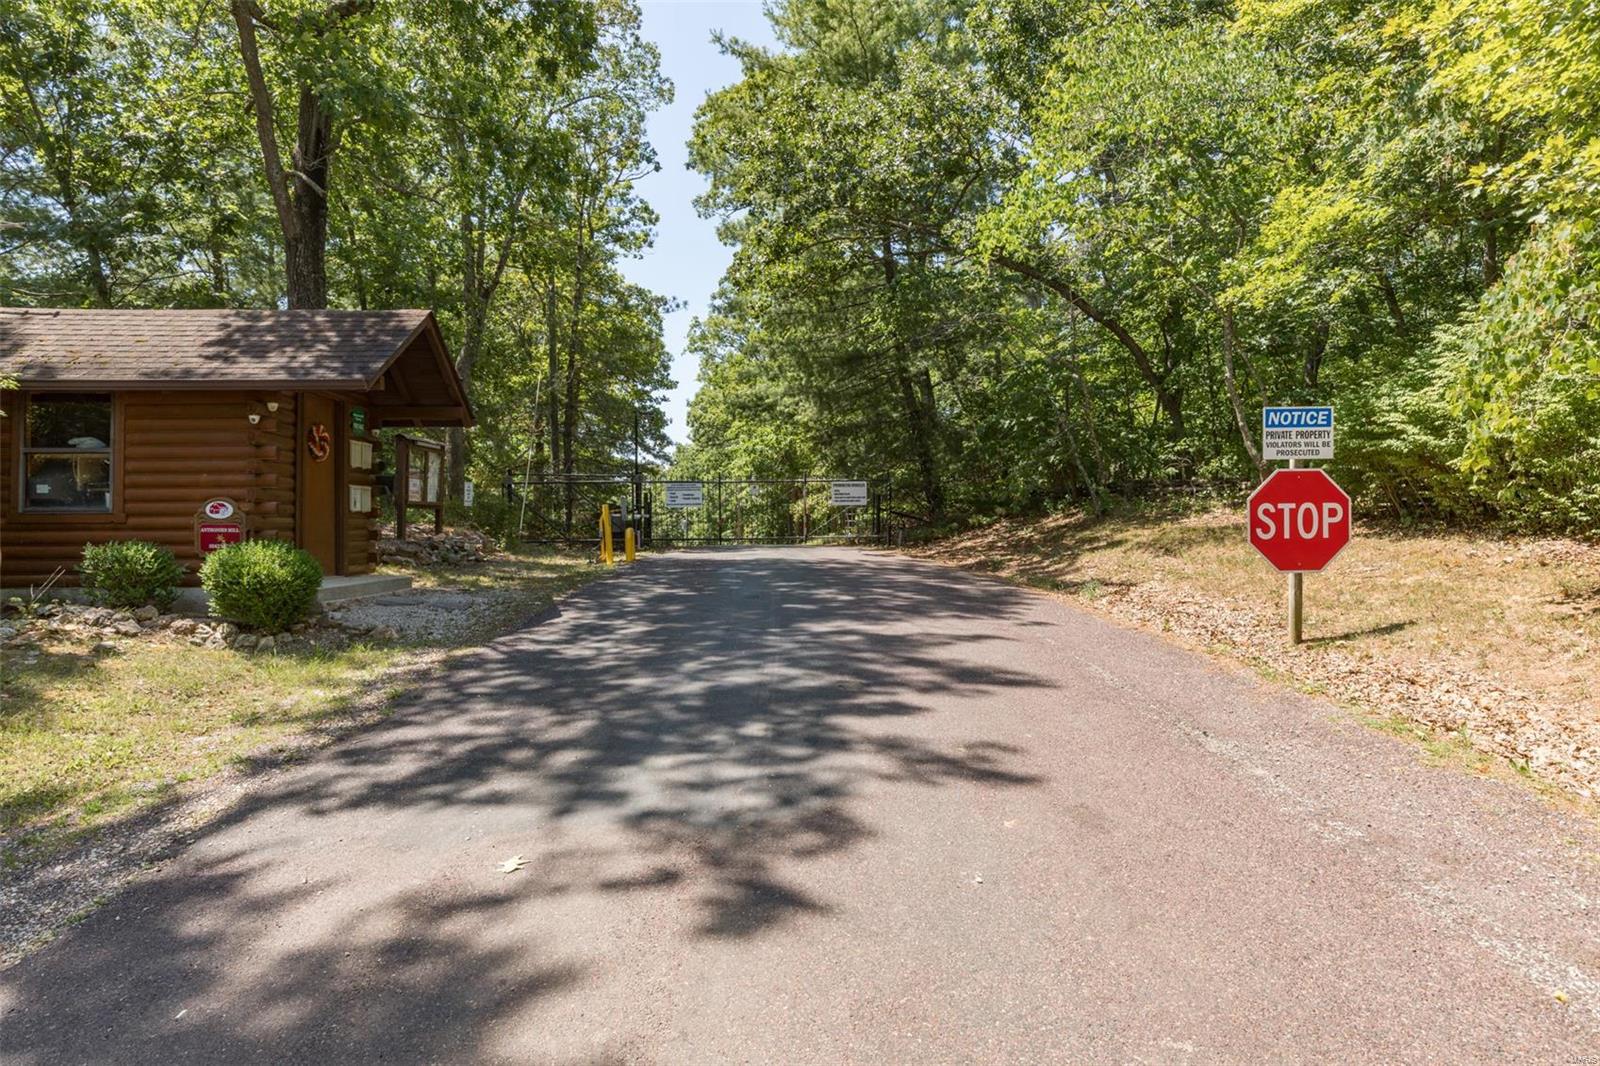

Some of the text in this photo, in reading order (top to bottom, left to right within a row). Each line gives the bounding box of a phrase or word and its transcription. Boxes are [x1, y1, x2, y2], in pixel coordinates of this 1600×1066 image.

[1268, 411, 1329, 425] NOTICE
[1265, 430, 1331, 440] PRIVATE PROPERTY
[1321, 440, 1331, 448] BE
[1256, 502, 1343, 539] STOP
